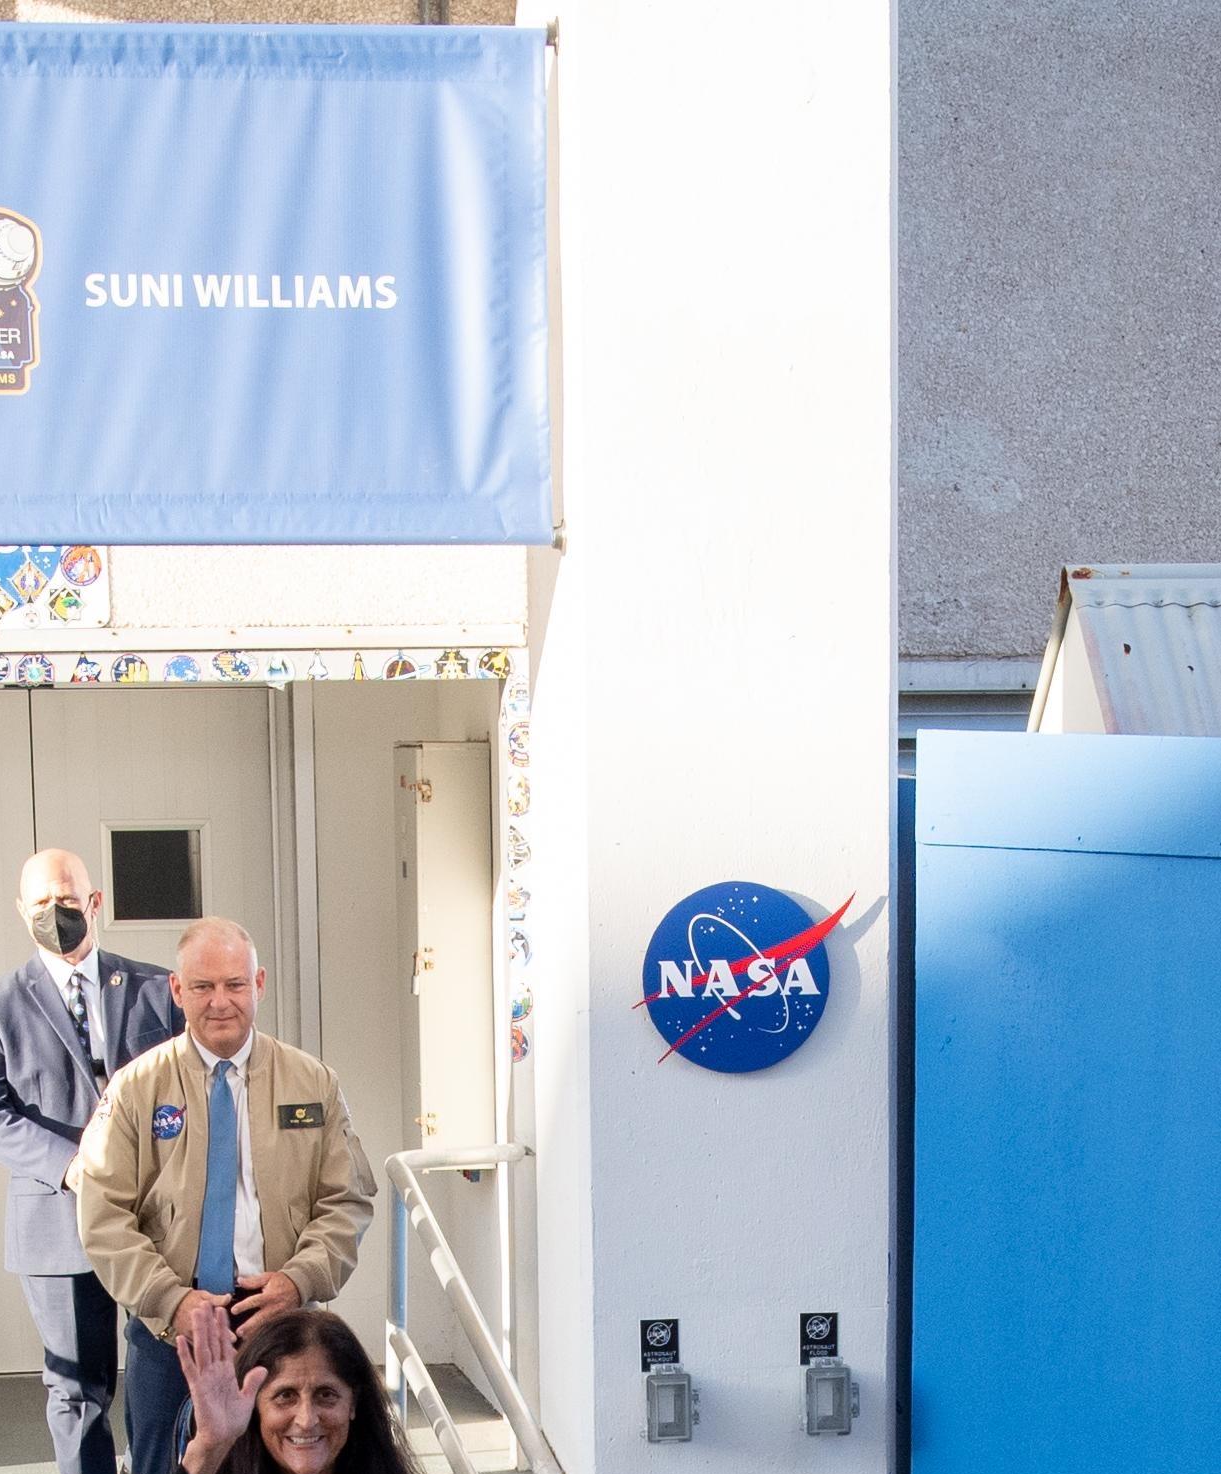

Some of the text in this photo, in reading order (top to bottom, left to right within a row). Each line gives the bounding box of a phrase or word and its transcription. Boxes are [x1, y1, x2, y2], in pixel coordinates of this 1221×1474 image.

[84, 272, 398, 310] SUNI WILLIAMS
[657, 957, 821, 998] NASA
[802, 1343, 836, 1351] ASTRONAUT
